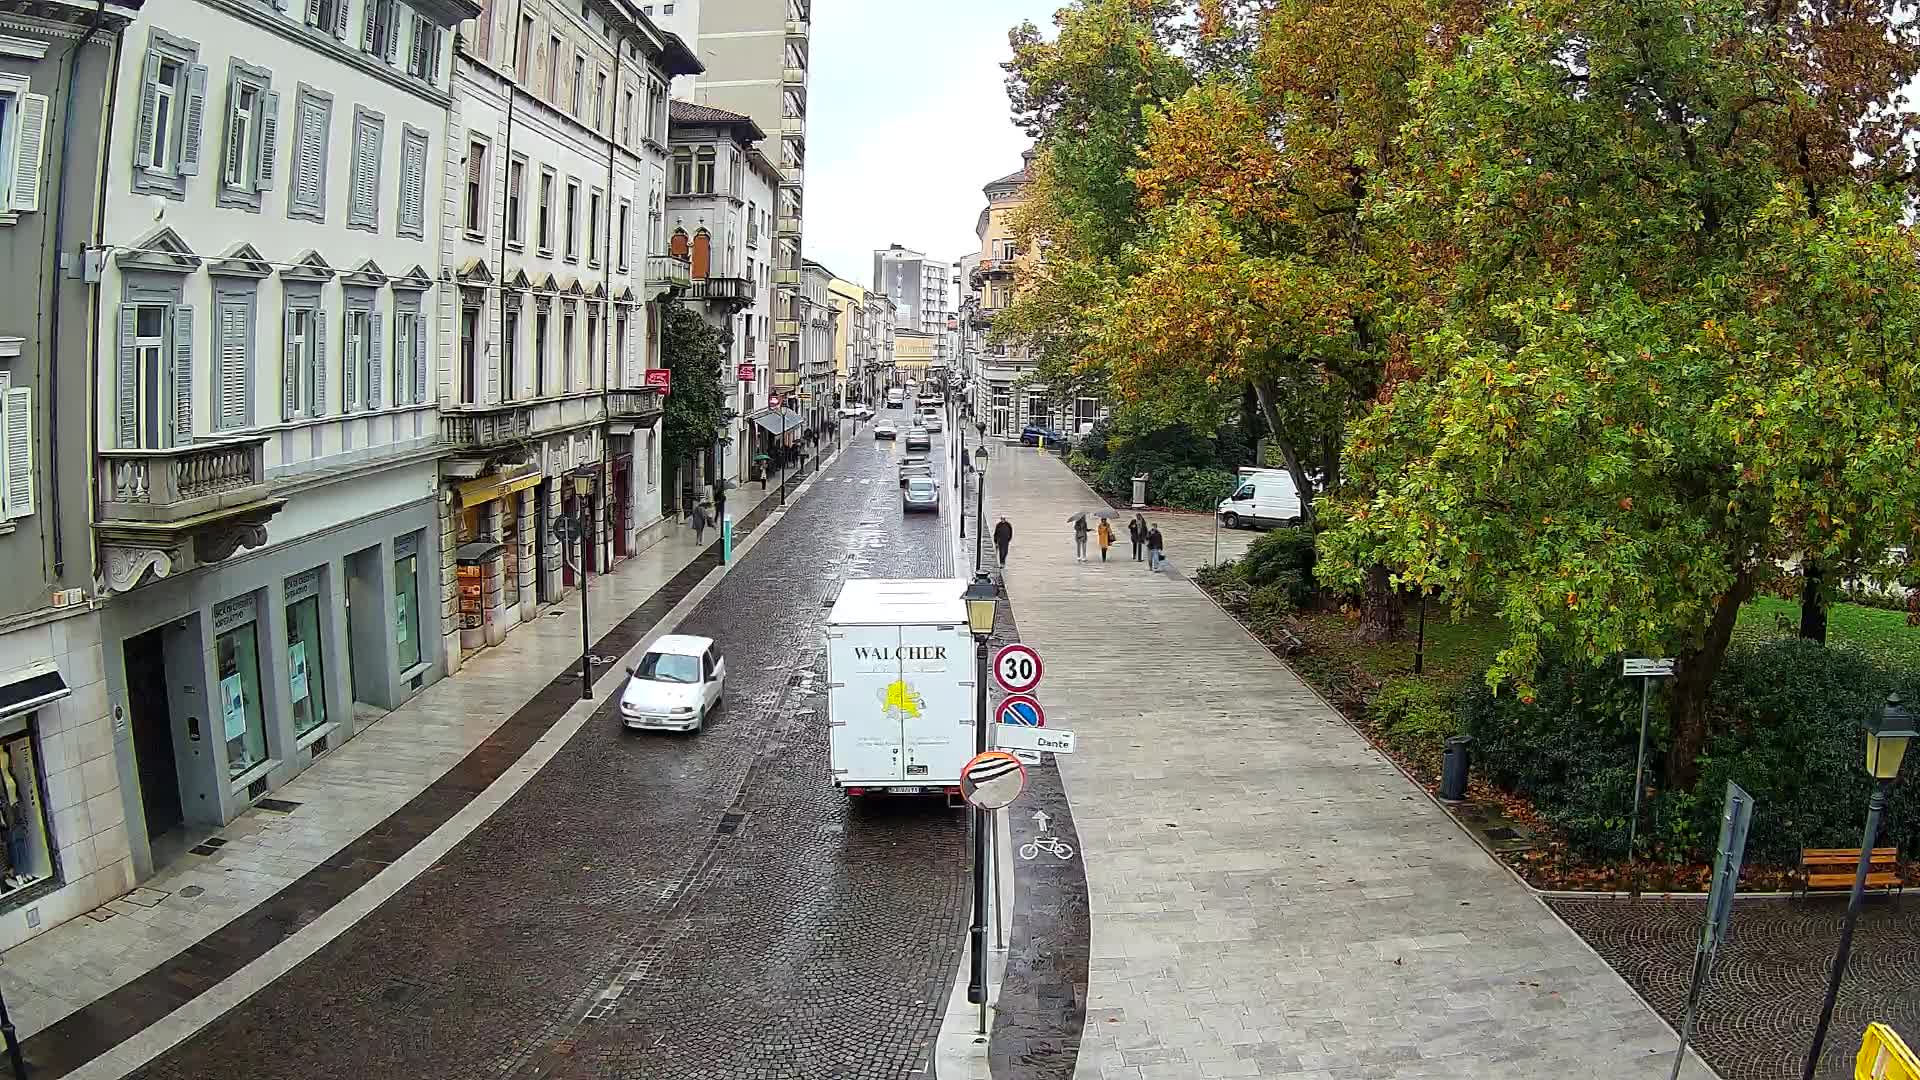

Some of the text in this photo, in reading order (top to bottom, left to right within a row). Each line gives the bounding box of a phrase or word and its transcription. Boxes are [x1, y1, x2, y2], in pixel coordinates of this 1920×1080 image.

[854, 646, 948, 660] WALCHER
[1004, 657, 1033, 680] 30
[1037, 737, 1070, 749] Dante
